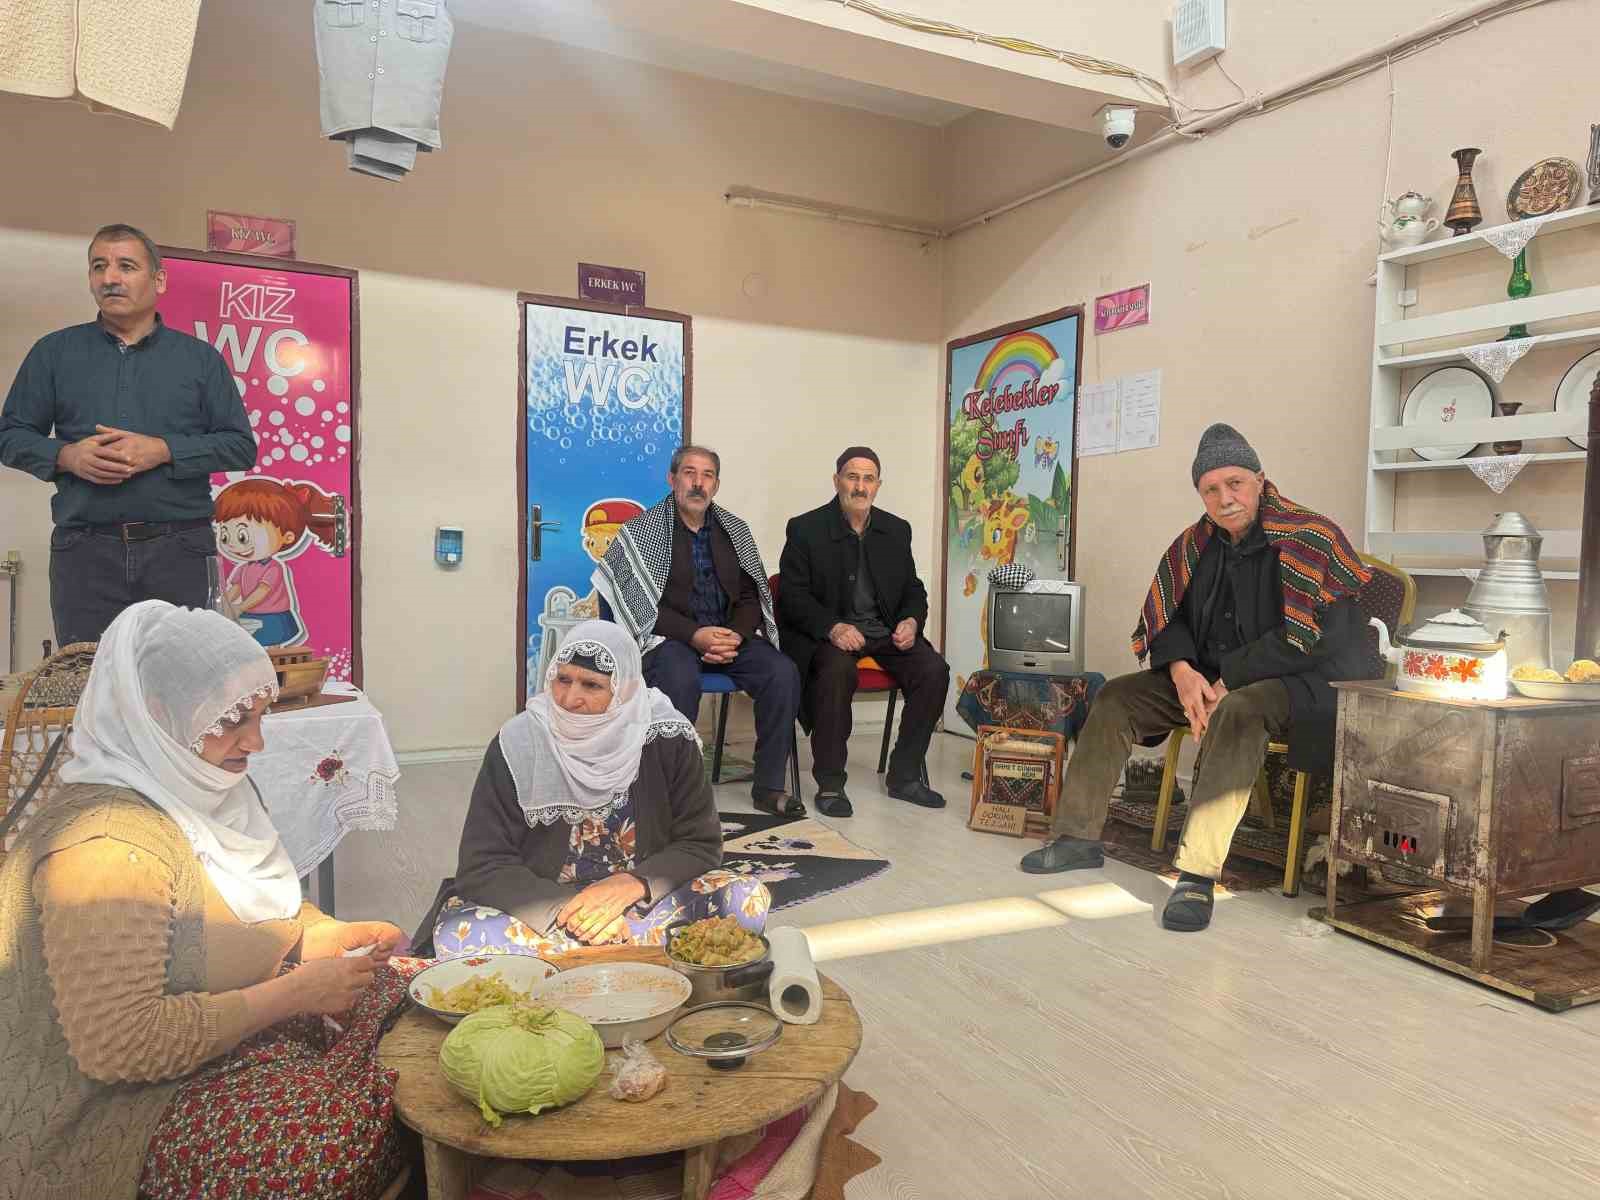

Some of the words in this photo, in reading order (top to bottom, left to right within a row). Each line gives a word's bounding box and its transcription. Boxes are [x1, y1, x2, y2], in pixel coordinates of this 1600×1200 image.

[219, 281, 296, 324] KIZ
[588, 276, 620, 292] ERKEK
[622, 282, 638, 294] WC
[194, 320, 310, 377] WC
[563, 326, 658, 363] Erkek
[562, 359, 651, 409] WC
[962, 377, 1060, 425] Kelebekler
